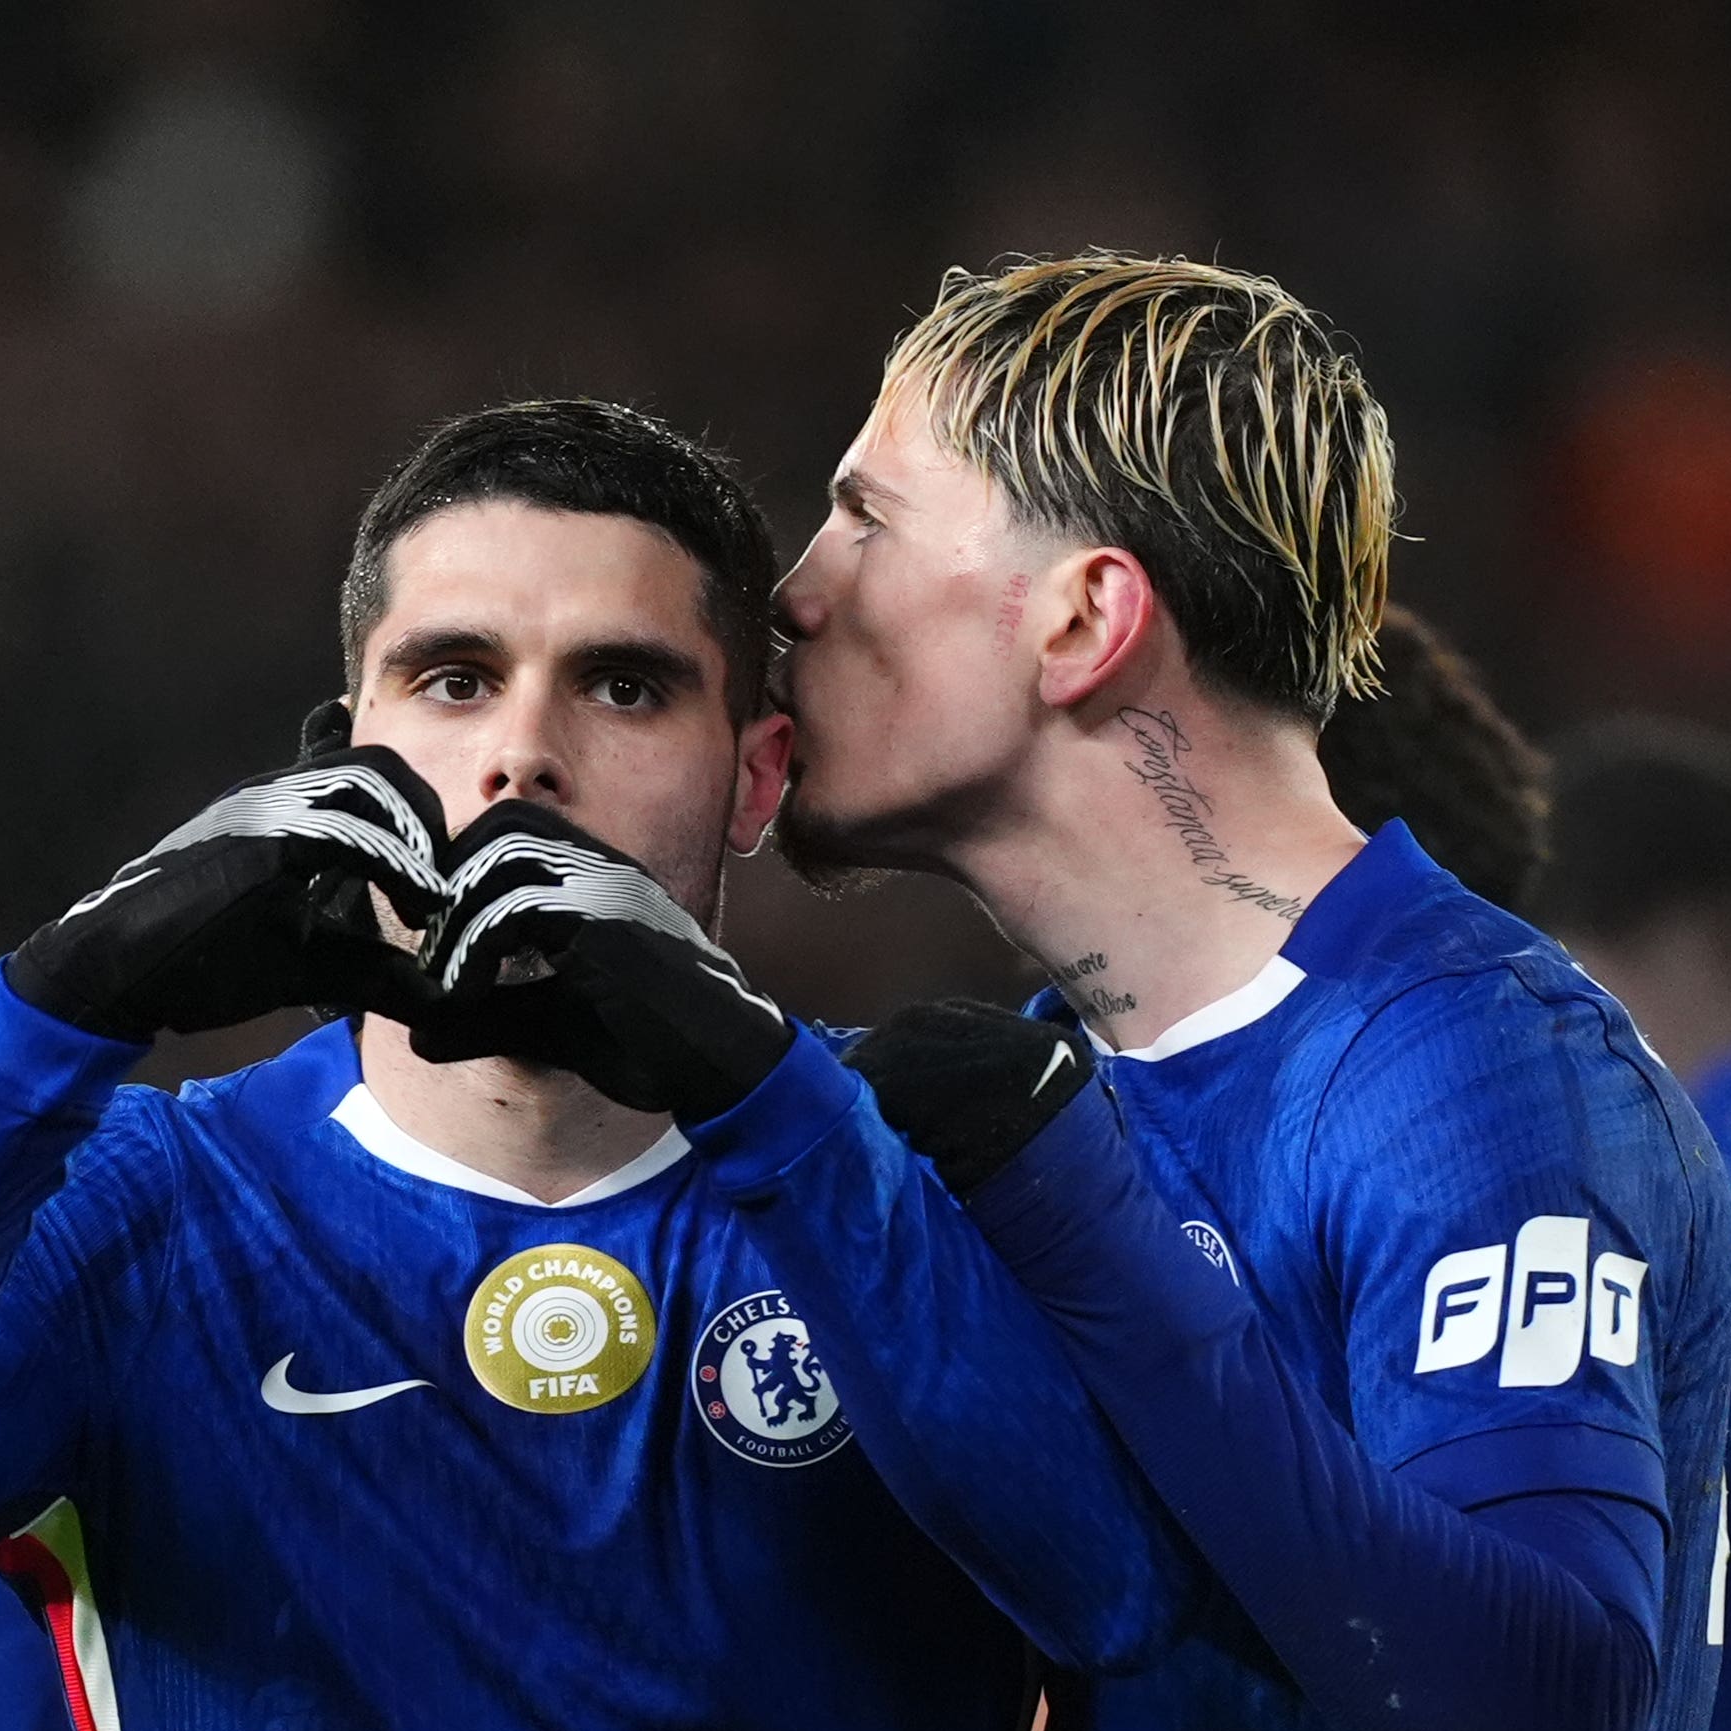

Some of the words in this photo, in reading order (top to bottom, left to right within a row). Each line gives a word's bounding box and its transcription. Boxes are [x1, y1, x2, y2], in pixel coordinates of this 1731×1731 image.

[483, 1276, 525, 1356] WORLD
[527, 1259, 638, 1345] CHAMPIONS
[713, 1297, 798, 1343] CHELS
[529, 1373, 601, 1400] FIFA
[736, 1433, 813, 1458] FOOTBALL
